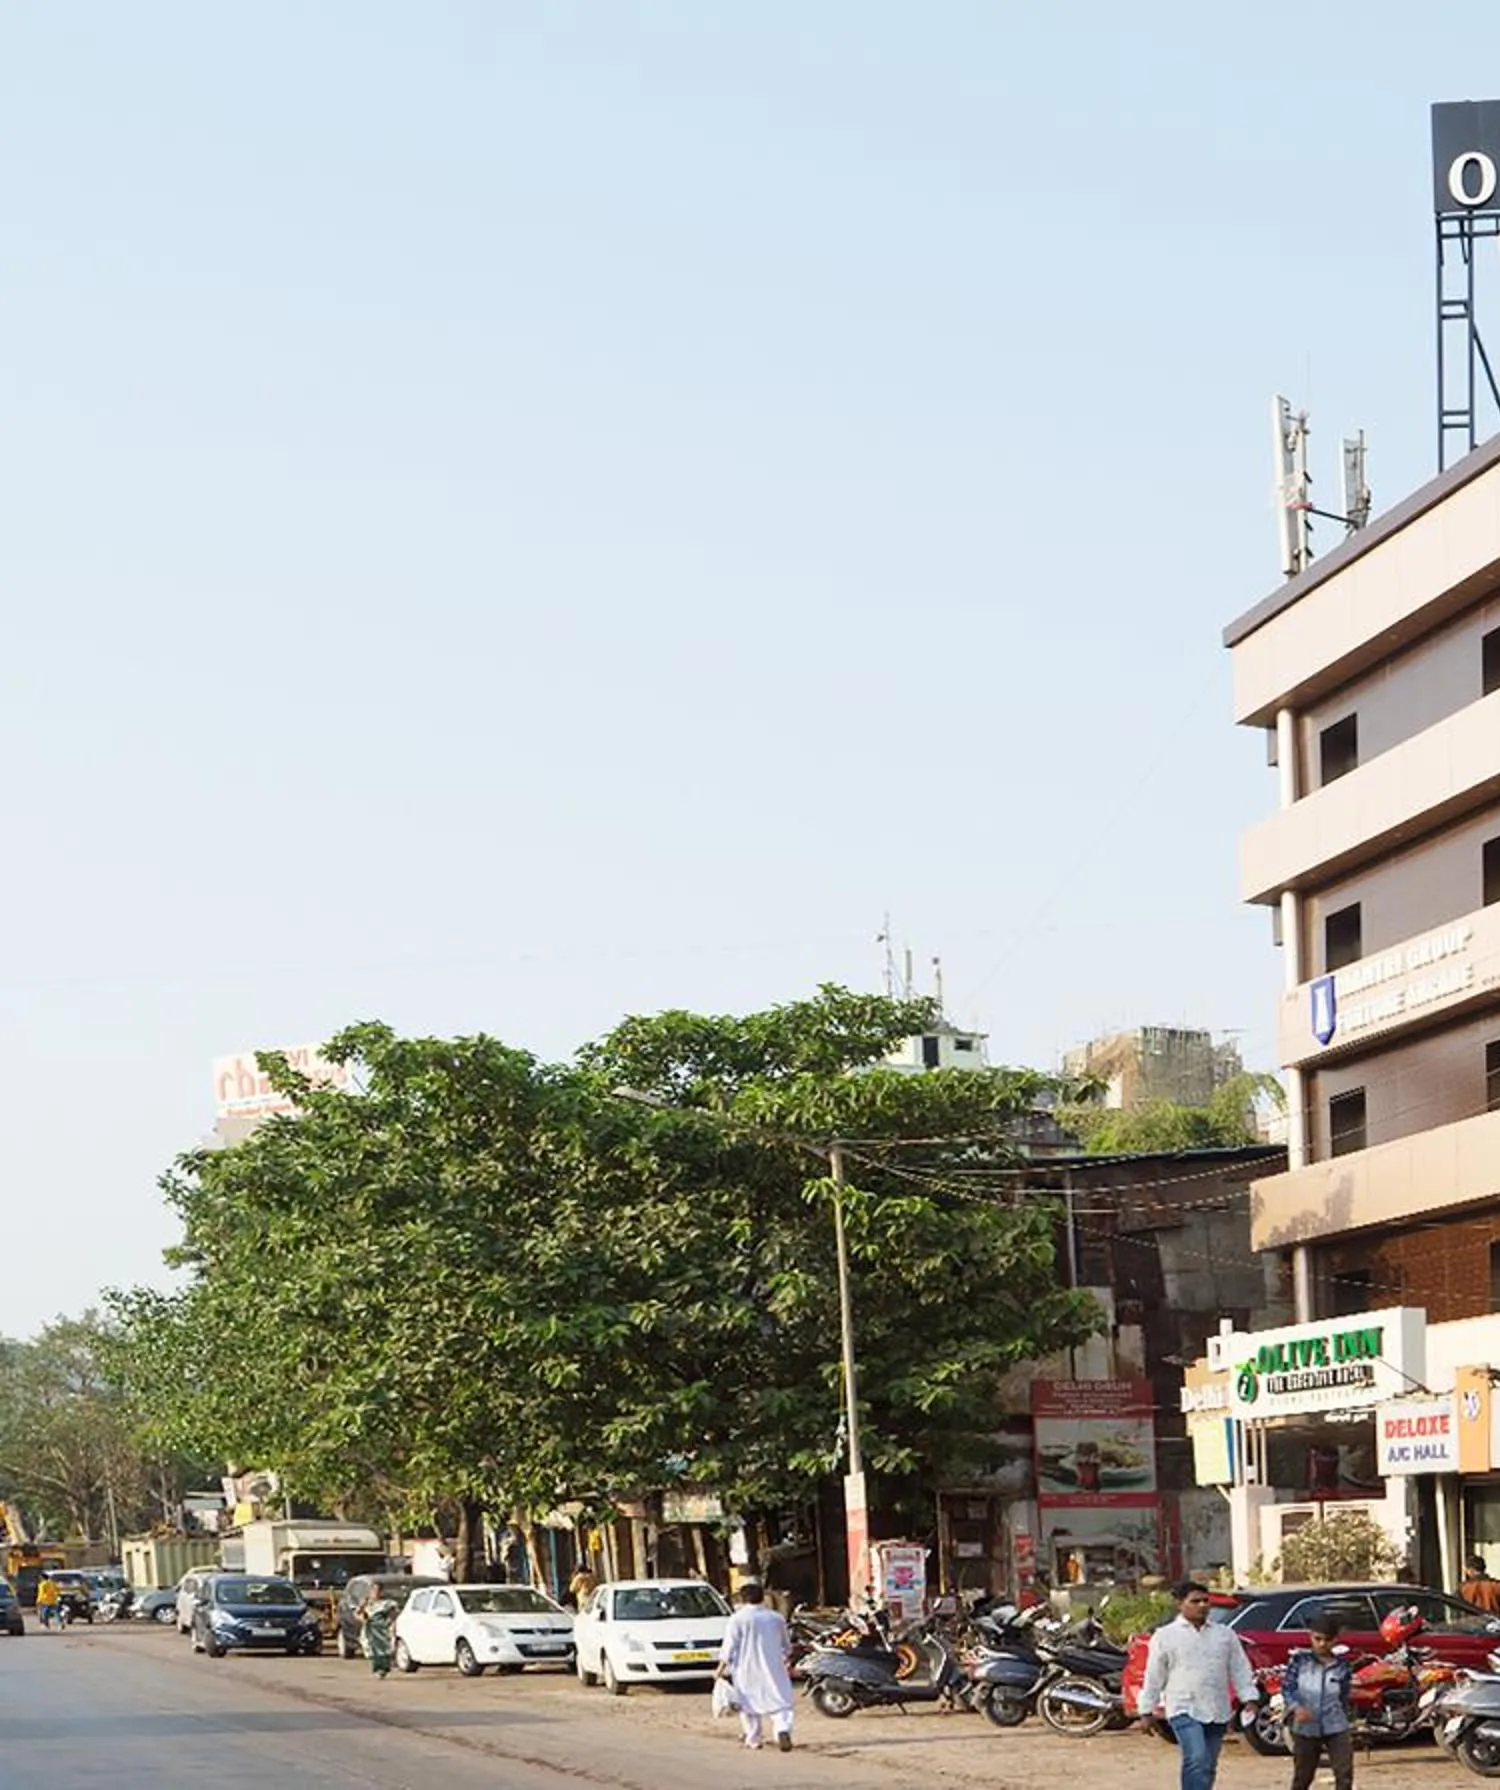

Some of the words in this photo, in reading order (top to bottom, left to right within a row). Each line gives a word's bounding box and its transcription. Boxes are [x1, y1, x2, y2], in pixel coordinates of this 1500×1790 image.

[1257, 1337, 1330, 1375] OLIVE
[1332, 1326, 1385, 1364] INN
[1384, 1414, 1451, 1439] DELUXE
[1413, 1444, 1449, 1461] HALL
